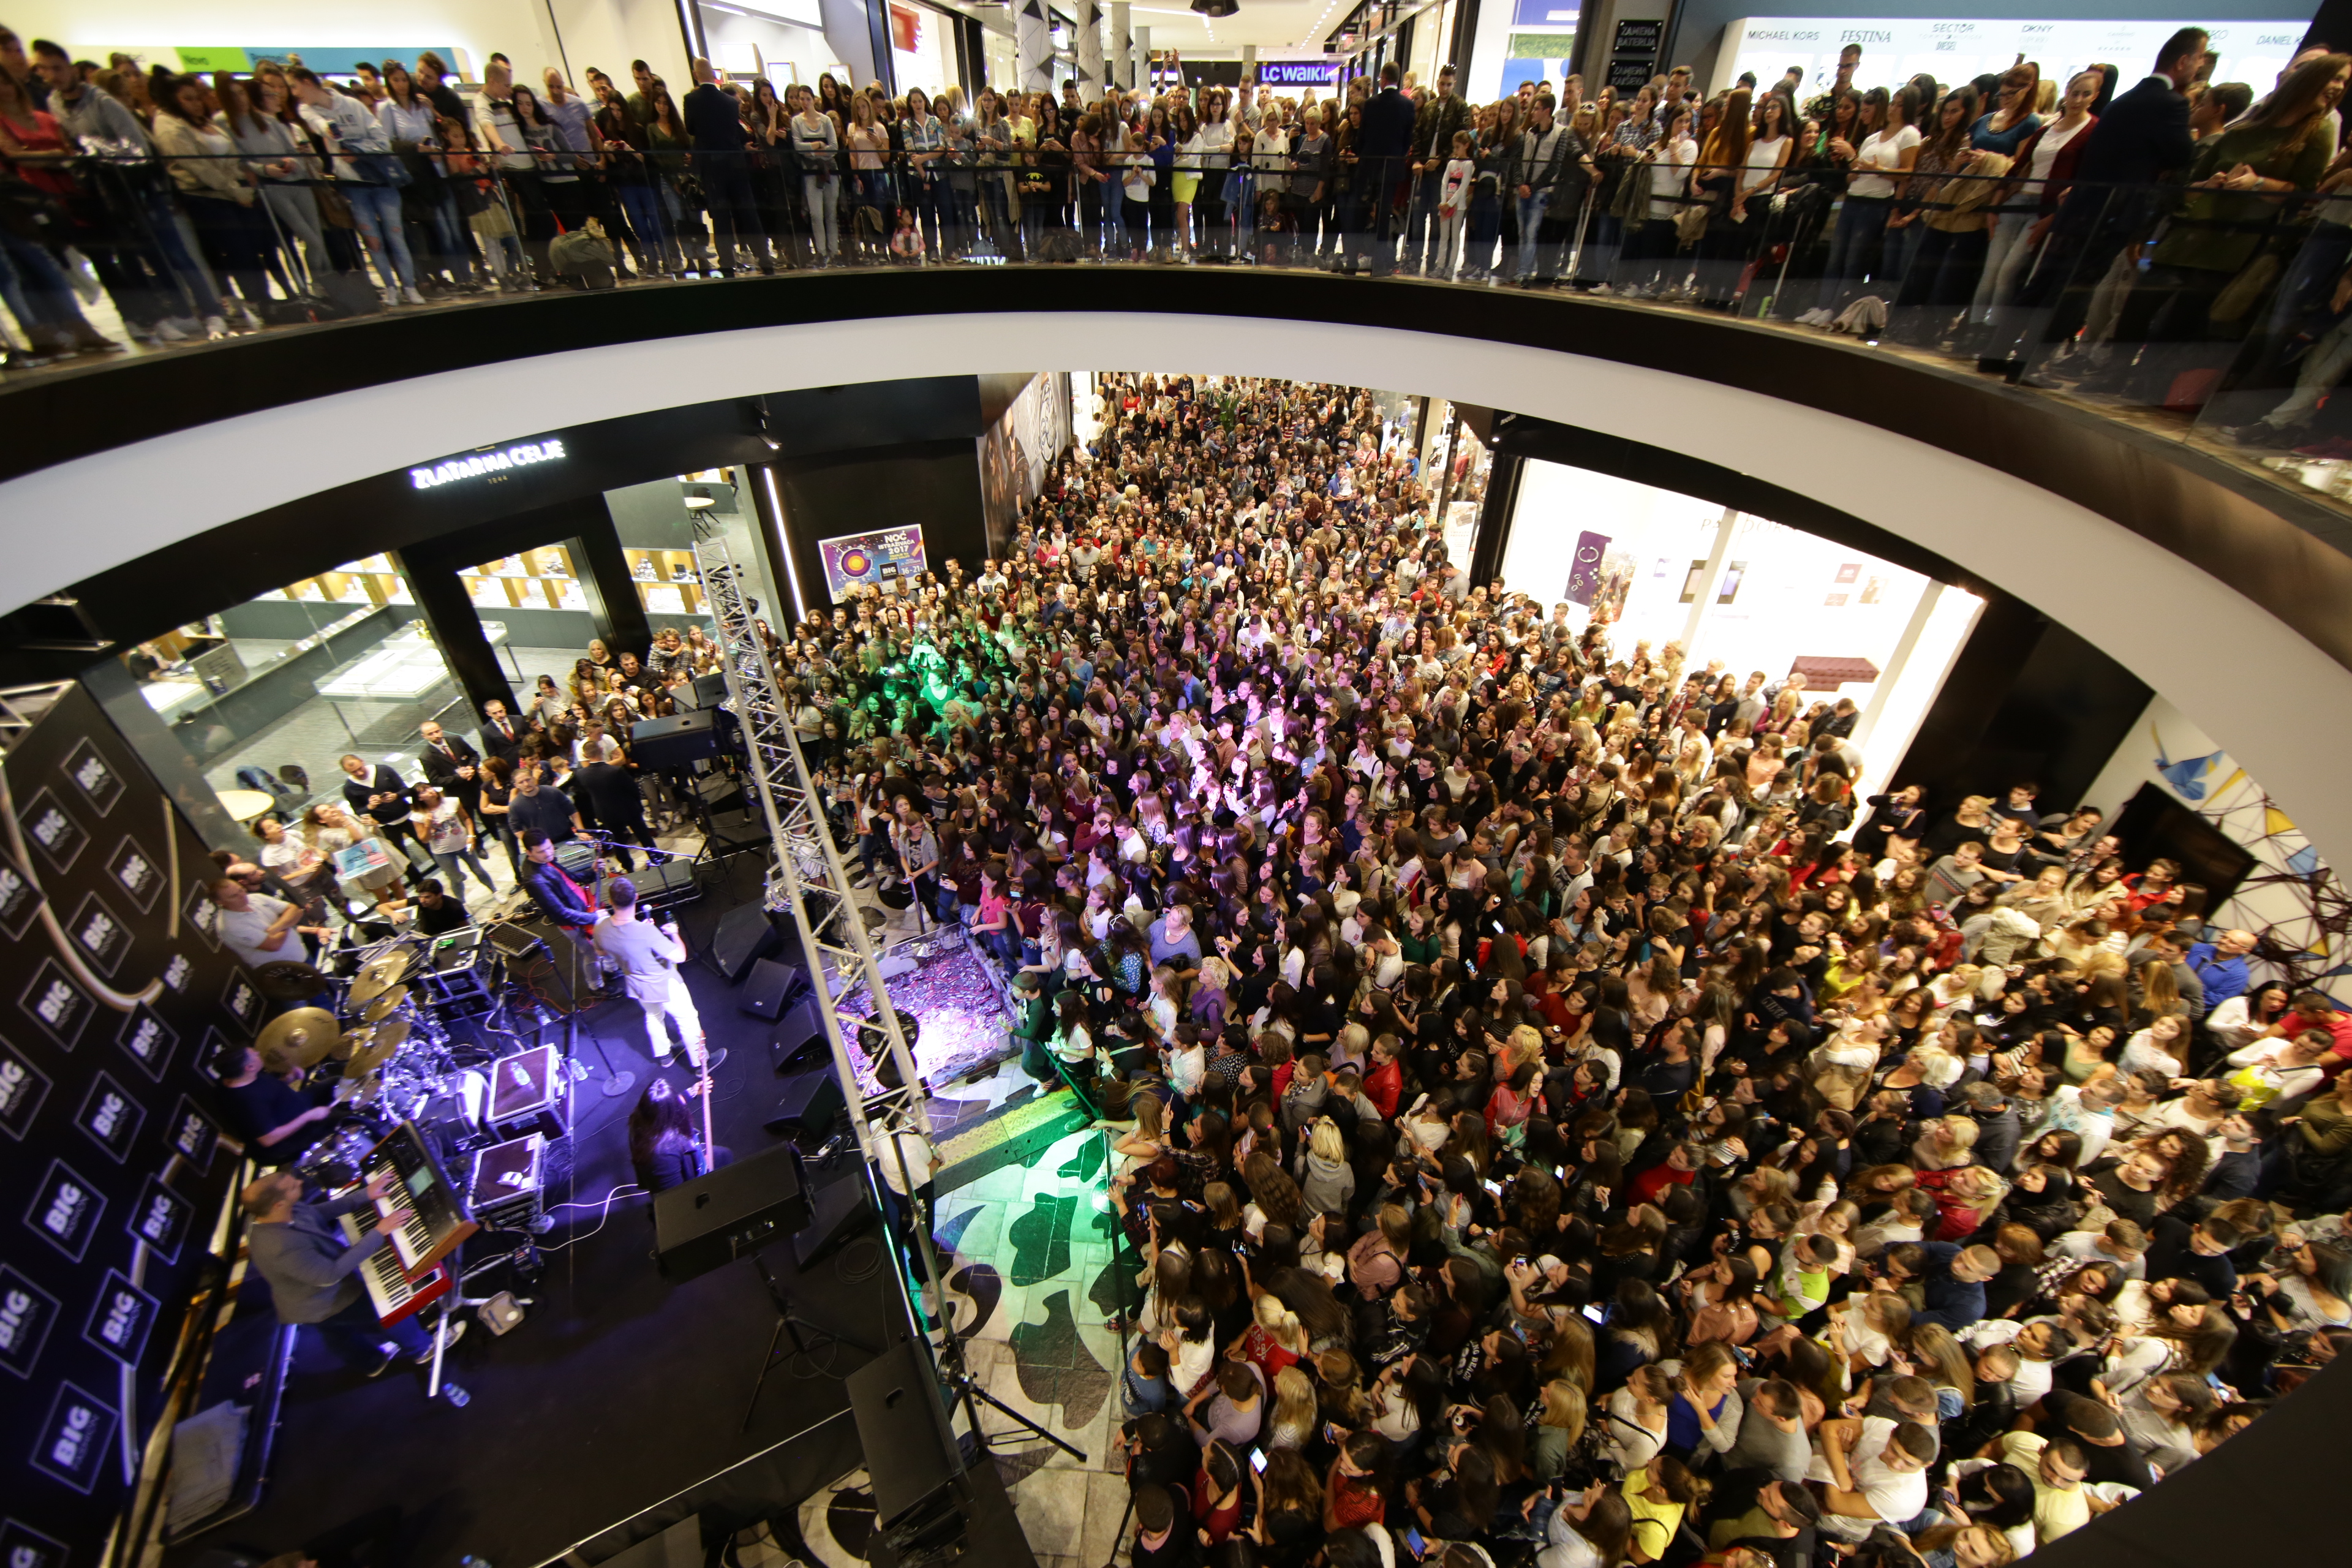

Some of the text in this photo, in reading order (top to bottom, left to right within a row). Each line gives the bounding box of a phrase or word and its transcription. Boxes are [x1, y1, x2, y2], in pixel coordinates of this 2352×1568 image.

[1621, 26, 1656, 36] ZAMENA
[1746, 31, 1820, 41] MICHAEL KORS
[1839, 30, 1891, 43] FESTINA
[1932, 23, 1975, 33] SECTOR
[2256, 36, 2293, 46] DANIEL
[1935, 41, 1958, 51] DIESEL
[1262, 66, 1280, 81] LC
[409, 440, 565, 489] ZLATARNA CELJE
[888, 545, 909, 554] 2017
[75, 757, 107, 790] BIG
[32, 808, 67, 845] BIG
[120, 855, 148, 888] BIG
[194, 898, 216, 930] BIG
[82, 913, 113, 950] BIG
[164, 954, 190, 989] BIG
[37, 980, 74, 1023] BIG
[232, 983, 252, 1016] BIG
[130, 1017, 159, 1057] BIG
[92, 1092, 124, 1137] BIG
[177, 1114, 203, 1154] BIG
[45, 1183, 82, 1234] BIG
[143, 1194, 173, 1240] BIG
[101, 1291, 135, 1344] BIG
[52, 1405, 91, 1467] BIG
